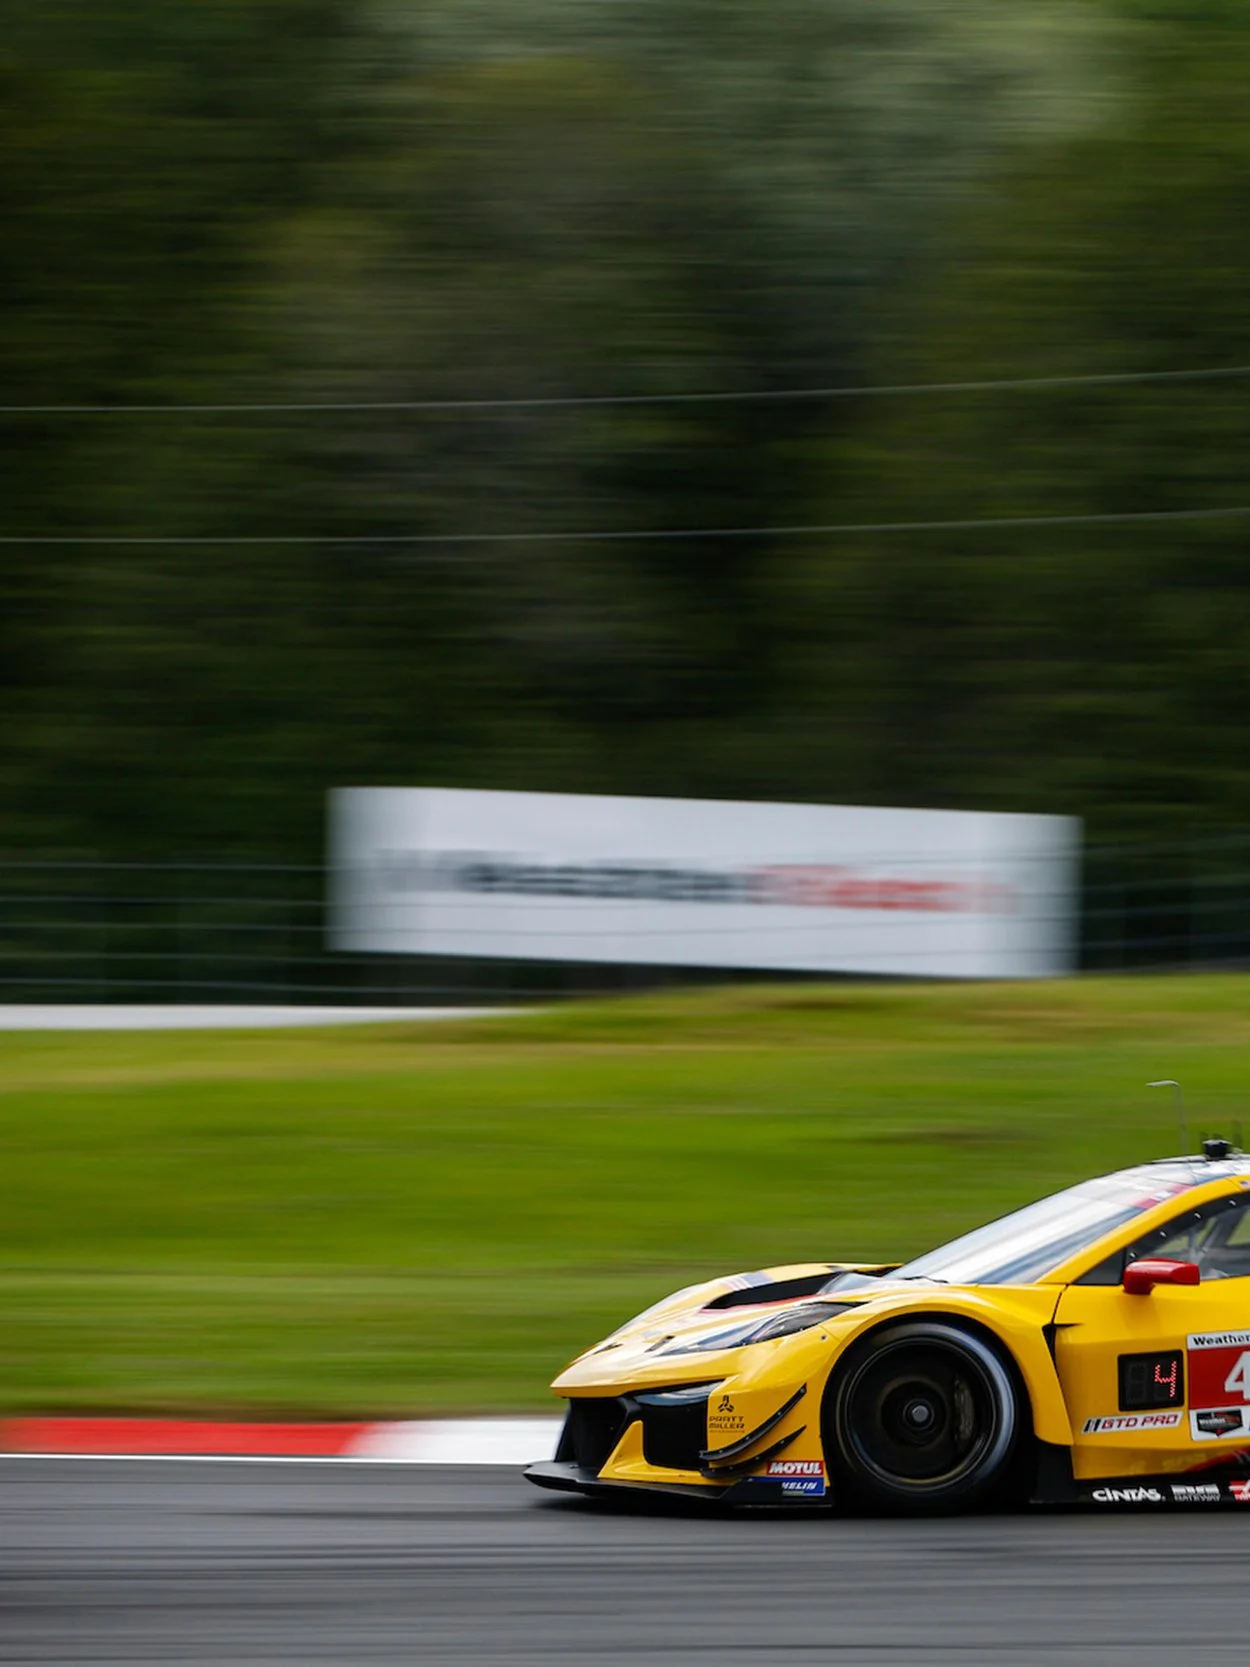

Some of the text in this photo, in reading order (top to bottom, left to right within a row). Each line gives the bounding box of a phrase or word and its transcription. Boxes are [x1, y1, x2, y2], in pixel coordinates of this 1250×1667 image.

[1154, 1359, 1178, 1399] 4
[1101, 1414, 1179, 1430] GTD PRO
[768, 1461, 822, 1475] MOTUL
